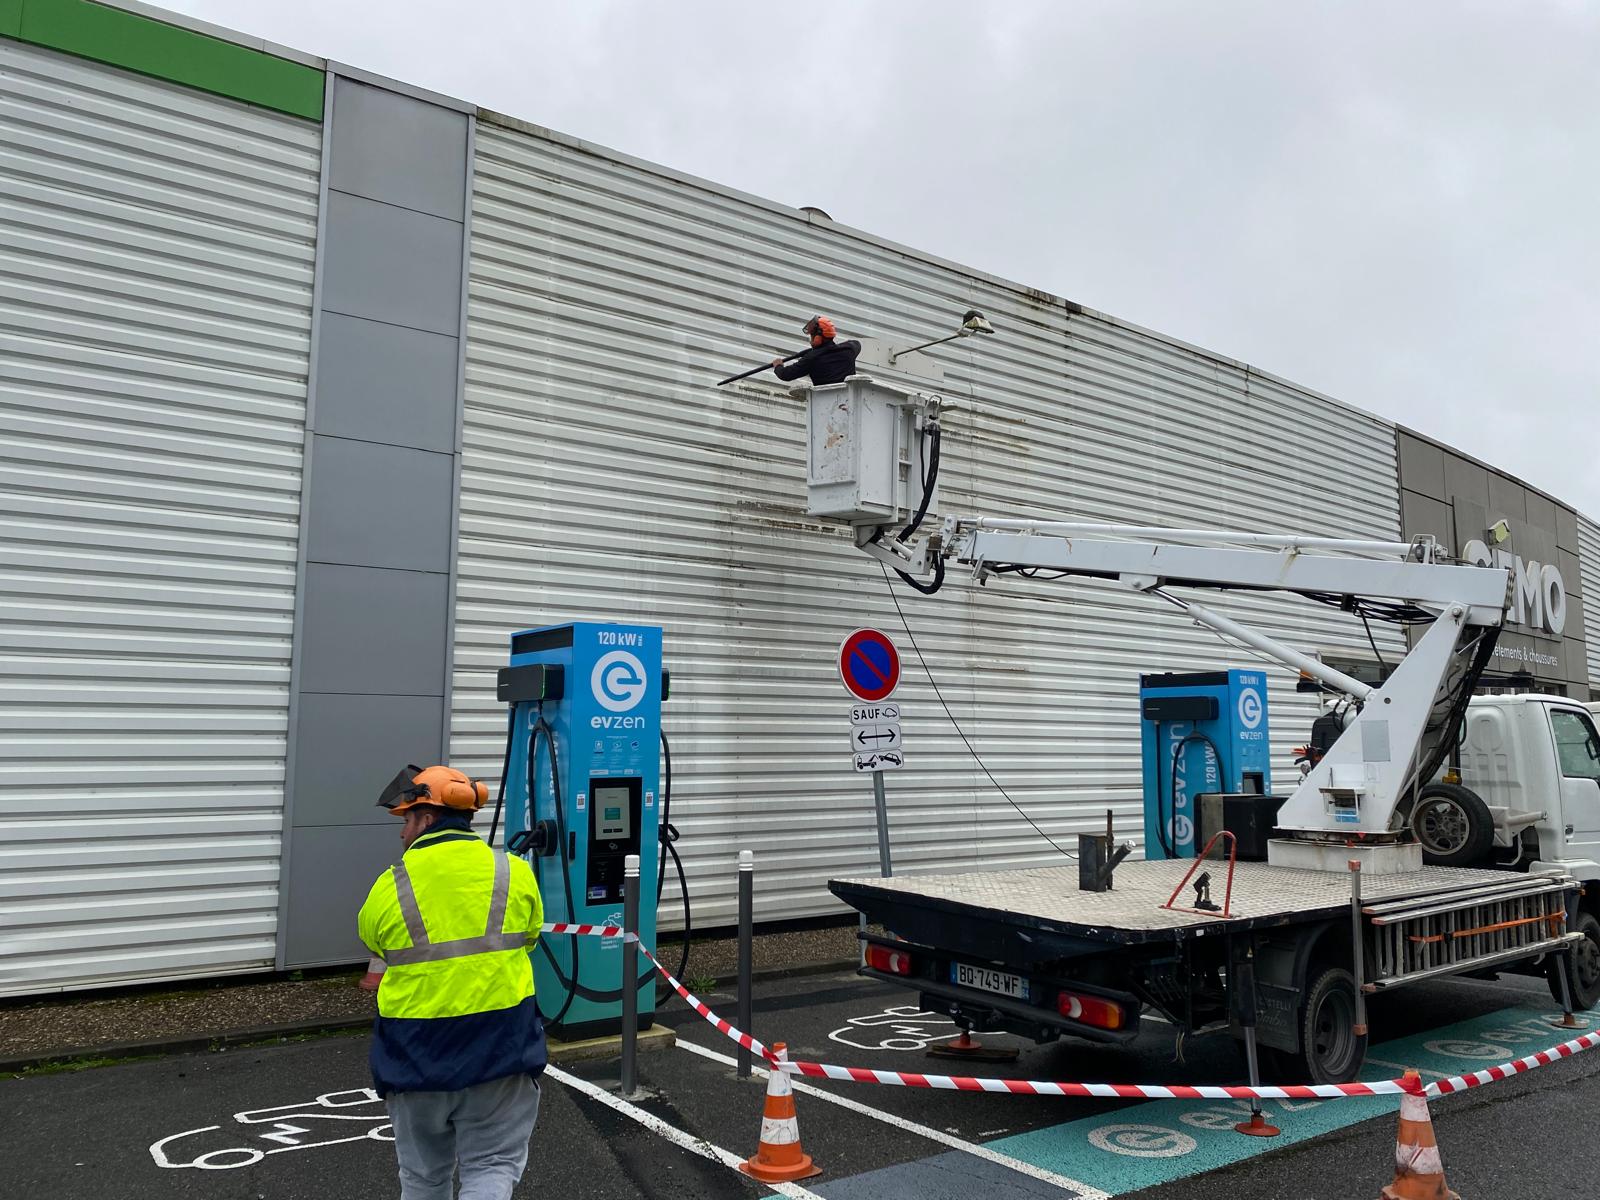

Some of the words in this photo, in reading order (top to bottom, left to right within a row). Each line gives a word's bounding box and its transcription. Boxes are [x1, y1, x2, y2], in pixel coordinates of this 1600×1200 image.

[598, 631, 616, 645] 120
[617, 632, 637, 646] kW
[853, 708, 881, 720] SAUF
[590, 715, 645, 729] evzen
[1239, 731, 1263, 741] evzen
[1205, 767, 1217, 784] 120
[959, 965, 1020, 994] BQ-749-WF
